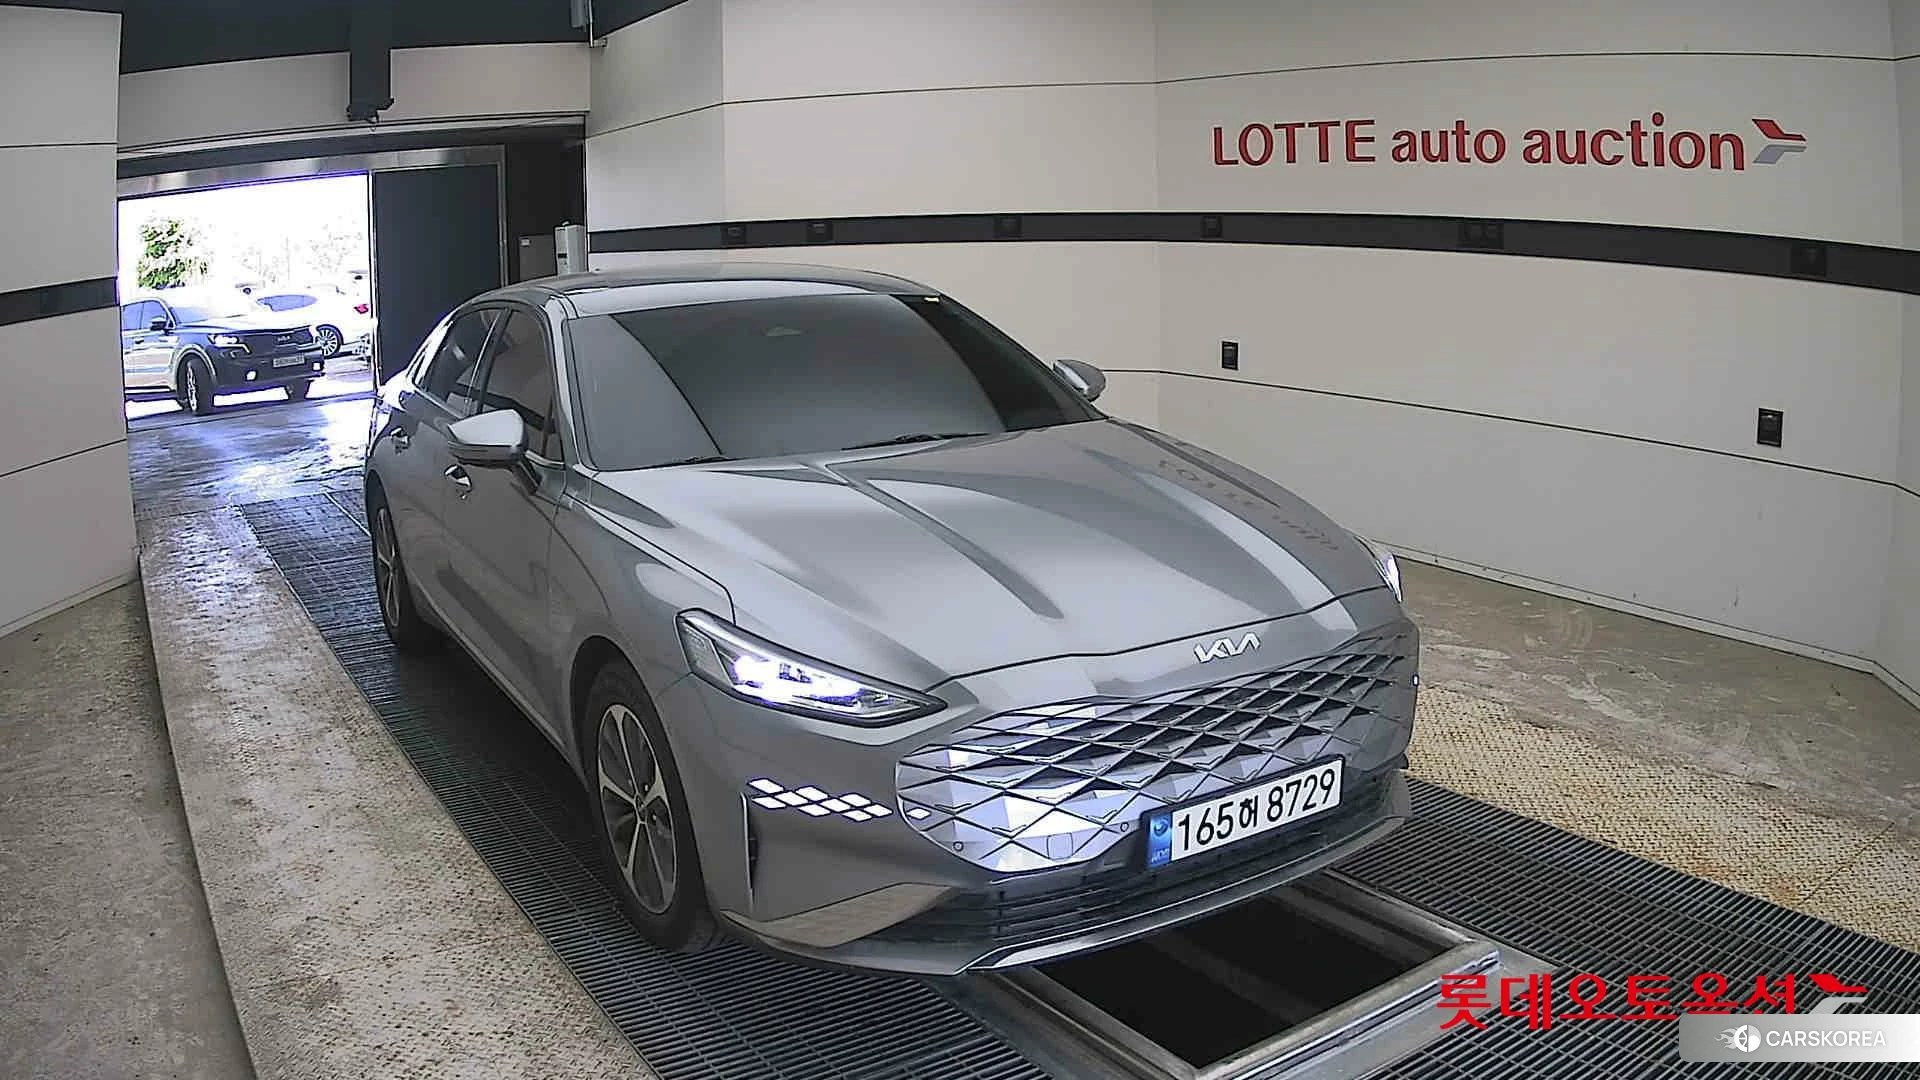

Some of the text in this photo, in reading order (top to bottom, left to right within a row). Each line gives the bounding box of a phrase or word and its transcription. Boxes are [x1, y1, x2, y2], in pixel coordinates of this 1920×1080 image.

[1213, 111, 1745, 171] LOTTE auto auction
[1194, 632, 1261, 663] KIA
[1267, 768, 1336, 823] 8729
